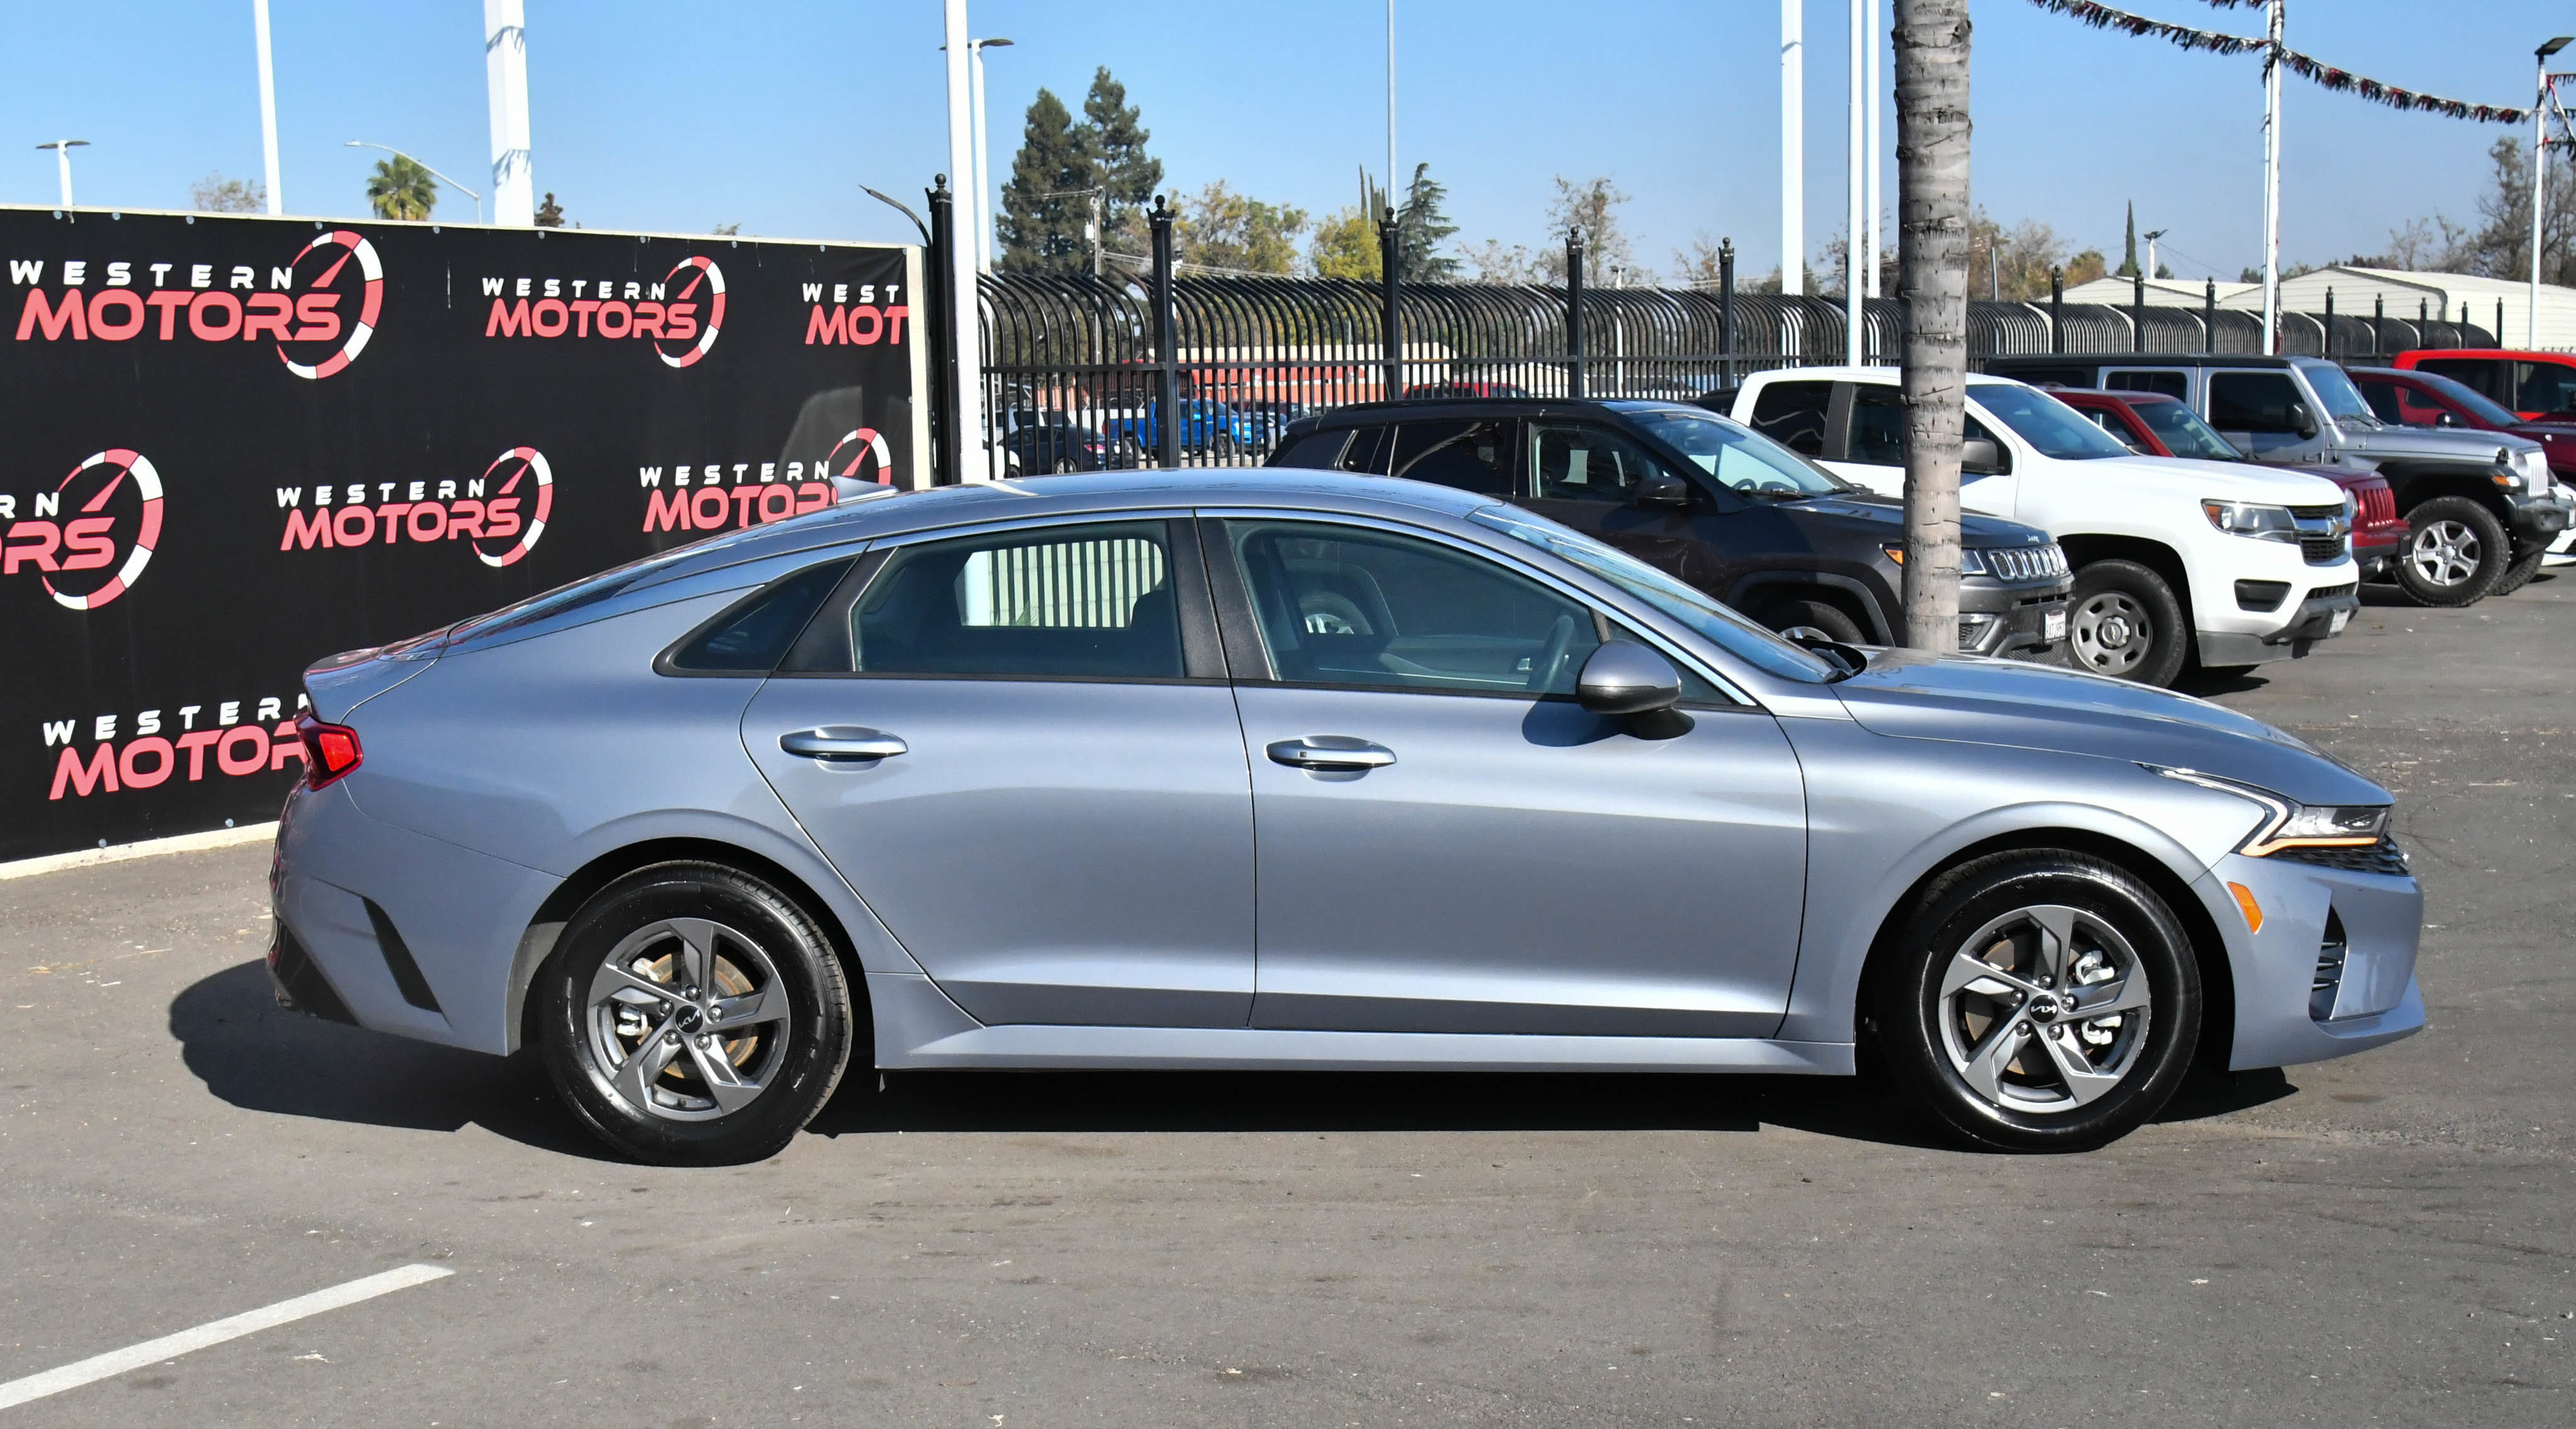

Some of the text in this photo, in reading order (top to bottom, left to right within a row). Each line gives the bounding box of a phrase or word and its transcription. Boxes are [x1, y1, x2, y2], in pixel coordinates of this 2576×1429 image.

[9, 260, 293, 290] WESTERN
[482, 277, 666, 301] WESTERN
[802, 283, 900, 304] WEST
[14, 287, 342, 342] MOTORS
[485, 297, 698, 340] MOTORS
[804, 304, 910, 346] MOT
[276, 479, 485, 508] WESTERN
[640, 460, 830, 488] WESTERN
[280, 496, 521, 552] MOTORS
[642, 481, 839, 533] MOTOR
[0, 516, 116, 576] RS
